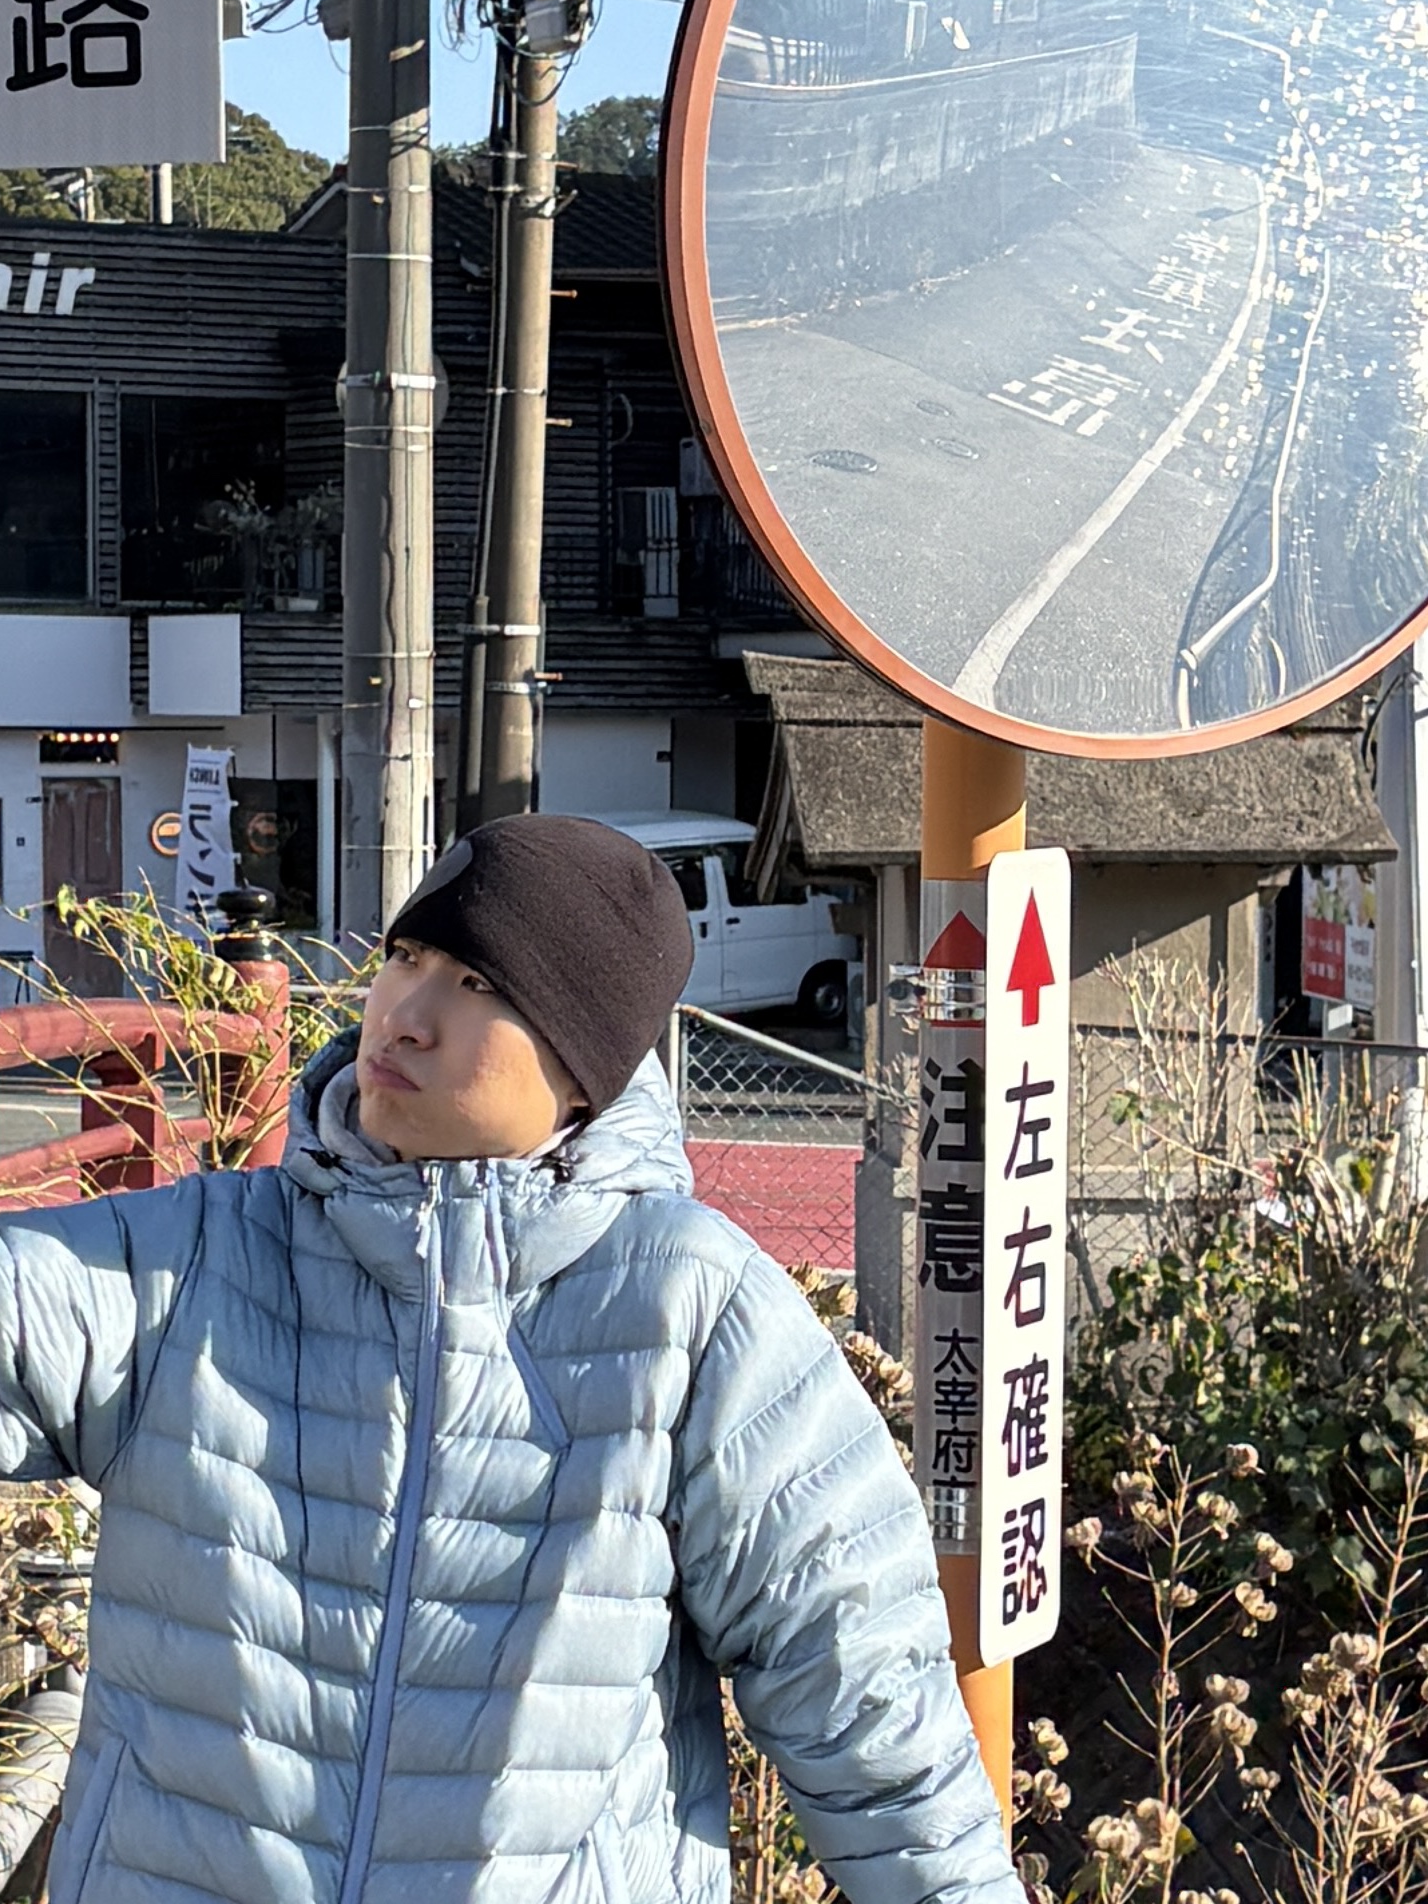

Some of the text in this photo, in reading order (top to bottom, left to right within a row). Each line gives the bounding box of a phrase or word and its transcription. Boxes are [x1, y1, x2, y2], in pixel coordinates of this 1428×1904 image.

[919, 1056, 985, 1294] 注意
[931, 1326, 978, 1489] 太宰府
[1002, 1061, 1056, 1627] 左右確認
